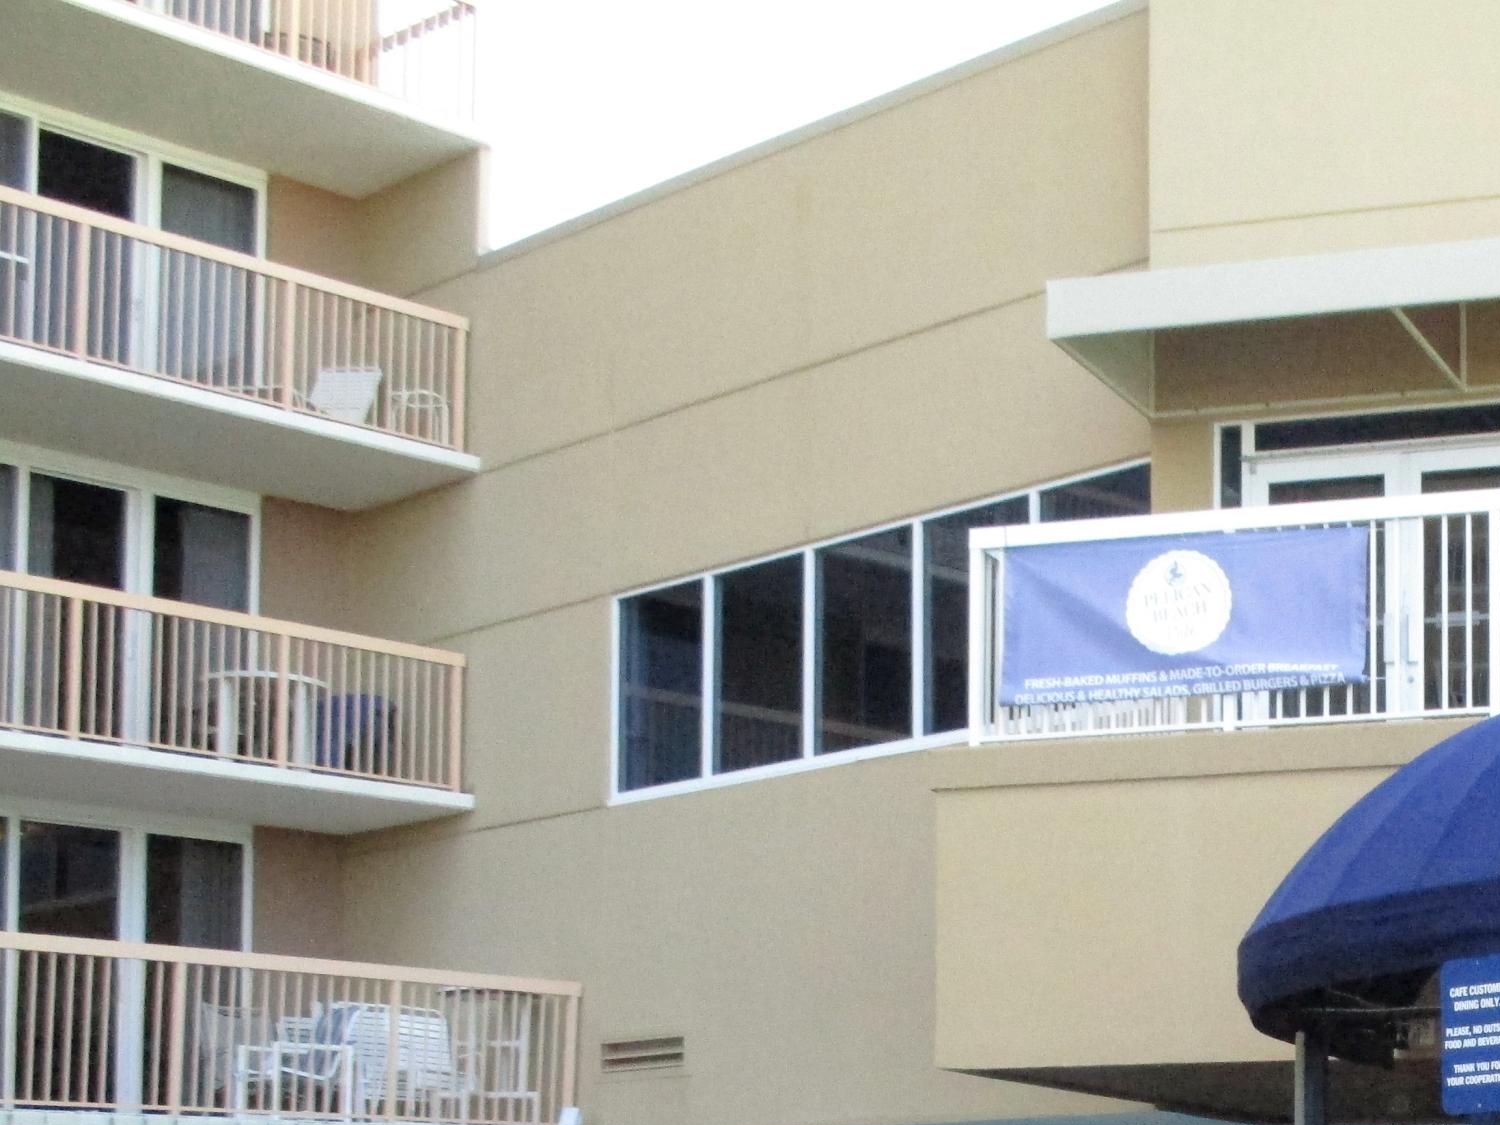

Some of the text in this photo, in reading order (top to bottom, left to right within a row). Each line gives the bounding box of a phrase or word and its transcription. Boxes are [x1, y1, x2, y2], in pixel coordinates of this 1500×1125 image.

[1024, 674, 1104, 690] FRESH-BAKED
[1105, 671, 1157, 685] MUFFINS
[1159, 670, 1168, 682] &
[1169, 662, 1266, 681] MADE-TO-ORDER
[1077, 690, 1086, 702] &
[1088, 686, 1142, 701] HEALTHY
[1192, 681, 1241, 695] GRILLED
[1243, 675, 1298, 692] BURGERS
[1300, 674, 1309, 687] &
[1311, 671, 1346, 686] PIZZA
[1450, 985, 1468, 998] CAFE
[1454, 999, 1480, 1012] DINING
[1446, 1026, 1472, 1038] PLEASE,
[1472, 1024, 1482, 1035] NO
[1444, 1038, 1462, 1050] FOOD
[1463, 1037, 1476, 1048] AND
[1454, 1063, 1476, 1074] THANK
[1476, 1062, 1490, 1072] YOU
[1446, 1076, 1464, 1086] YOUR
